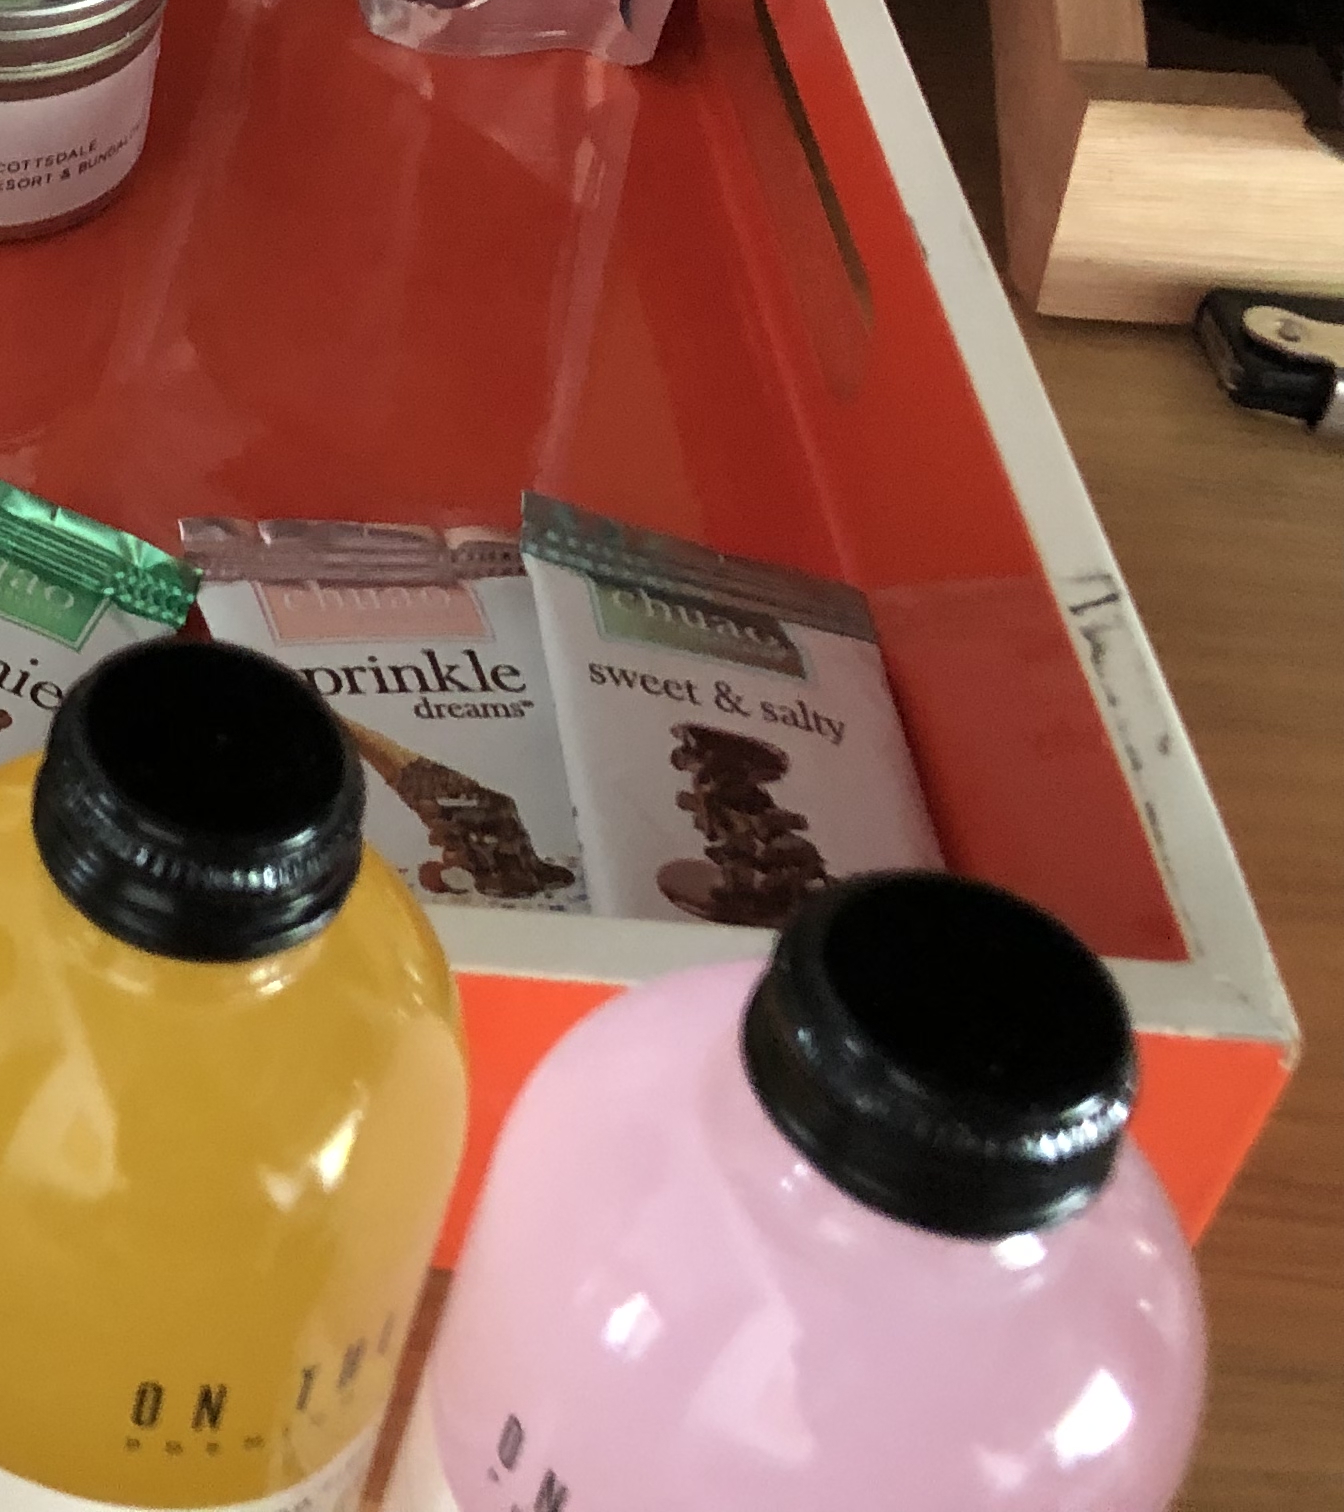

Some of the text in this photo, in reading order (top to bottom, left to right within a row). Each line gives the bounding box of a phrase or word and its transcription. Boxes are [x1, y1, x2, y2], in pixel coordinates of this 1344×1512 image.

[299, 647, 528, 697] prinkle
[588, 661, 847, 746] sweet & salty
[130, 1380, 228, 1433] ON
